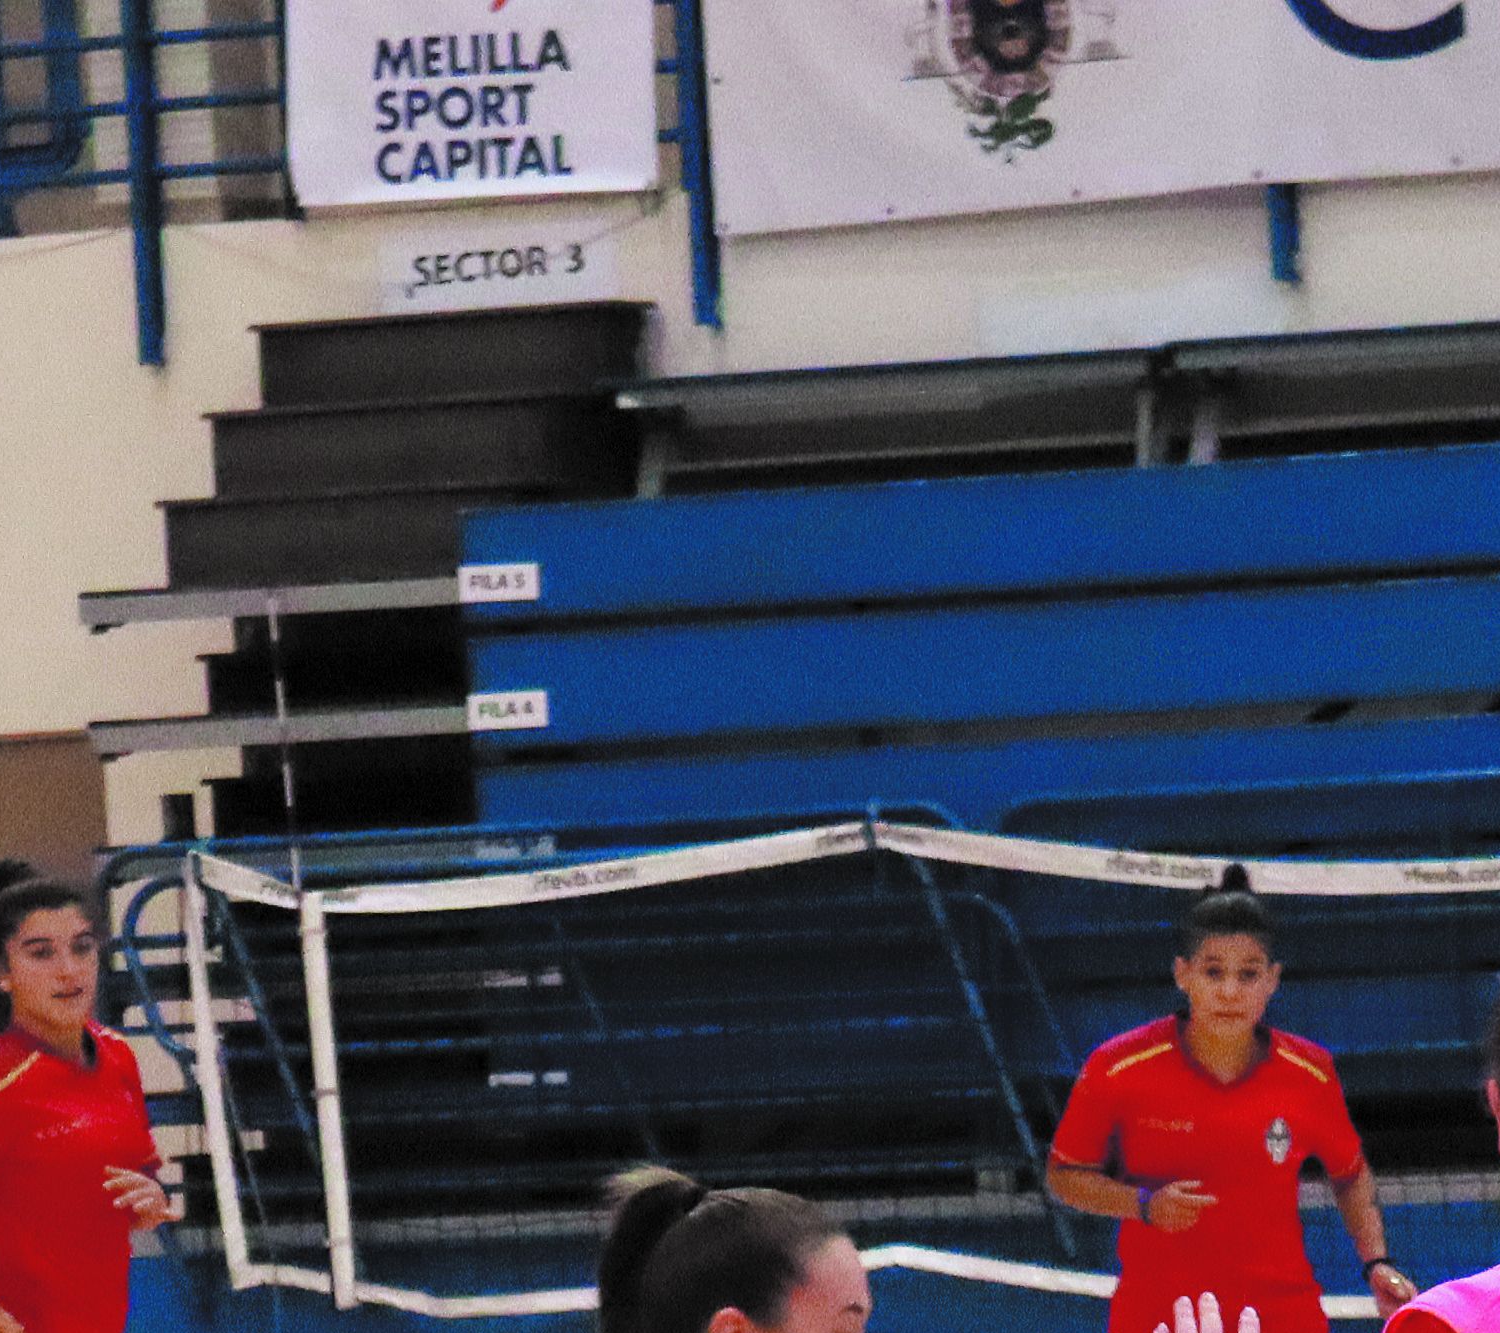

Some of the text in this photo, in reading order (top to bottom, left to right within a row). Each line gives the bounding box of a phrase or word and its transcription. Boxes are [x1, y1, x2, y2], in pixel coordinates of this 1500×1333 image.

[373, 27, 571, 84] MELILLA
[374, 83, 534, 134] SPORT
[374, 134, 574, 185] CAPITAL
[412, 242, 586, 288] SECTOR 3
[470, 573, 508, 591] FILA
[478, 701, 517, 718] FILA
